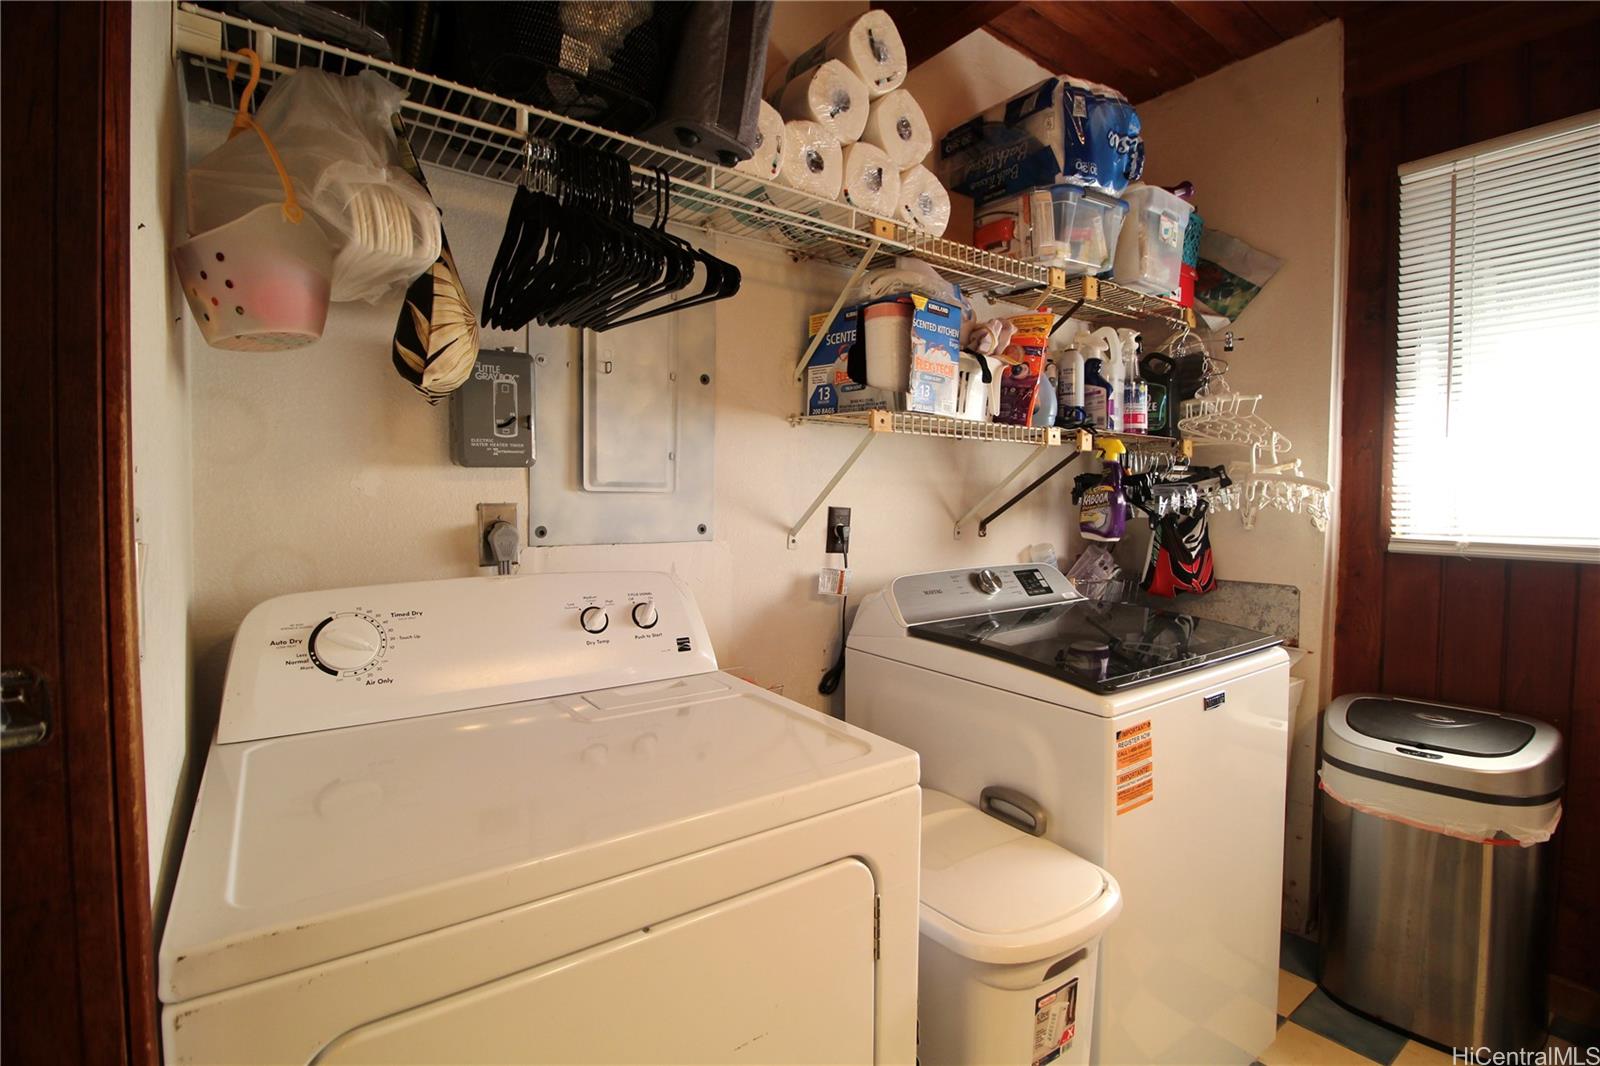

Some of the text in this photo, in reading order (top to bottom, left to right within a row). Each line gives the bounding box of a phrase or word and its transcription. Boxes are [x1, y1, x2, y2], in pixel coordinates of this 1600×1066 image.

[928, 303, 949, 314] KIRKLAND
[913, 317, 960, 338] SCENTED KITCHEN
[826, 329, 857, 346] SCENTE
[818, 383, 831, 400] 13
[919, 383, 930, 400] 13
[269, 638, 303, 647] Auto Dry
[285, 658, 310, 666] Normal
[365, 677, 394, 687] Air Only
